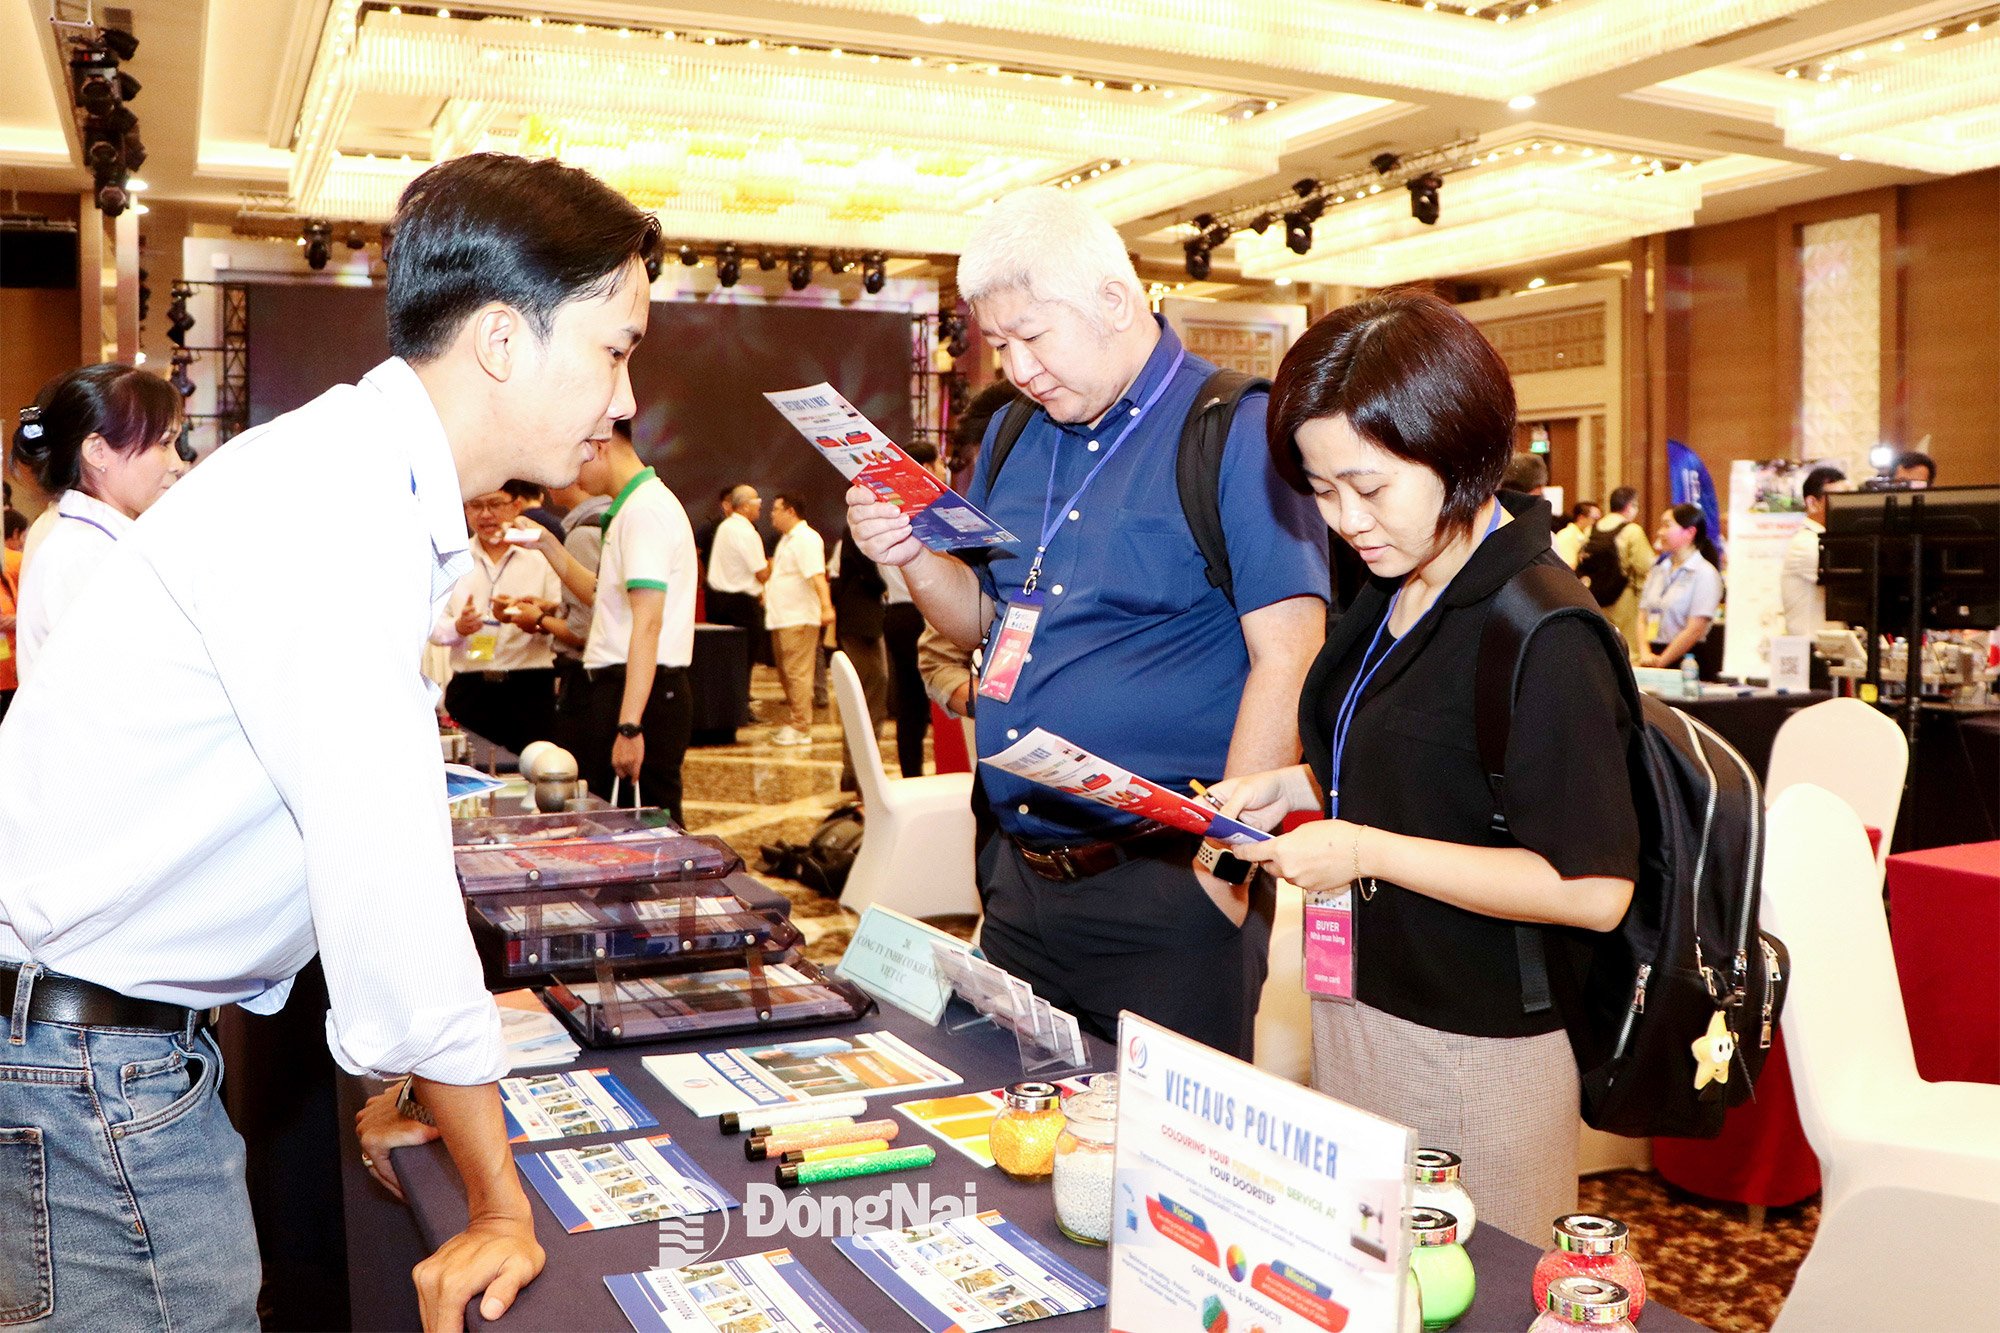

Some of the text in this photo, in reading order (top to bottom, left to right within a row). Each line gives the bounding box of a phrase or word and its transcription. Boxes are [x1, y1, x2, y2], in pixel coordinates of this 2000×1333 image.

[1316, 919, 1339, 932] BUYER
[1165, 1069, 1339, 1180] VIETAUS POLYMER
[1161, 1124, 1206, 1155] COLOURING
[1208, 1147, 1230, 1166] YOUR
[1286, 1185, 1323, 1213] SERVICE
[1210, 1164, 1231, 1183] YOUR
[1233, 1175, 1276, 1206] DOORSTEP
[1206, 1272, 1237, 1297] SERVICES
[1245, 1296, 1283, 1325] PRODUCTS
